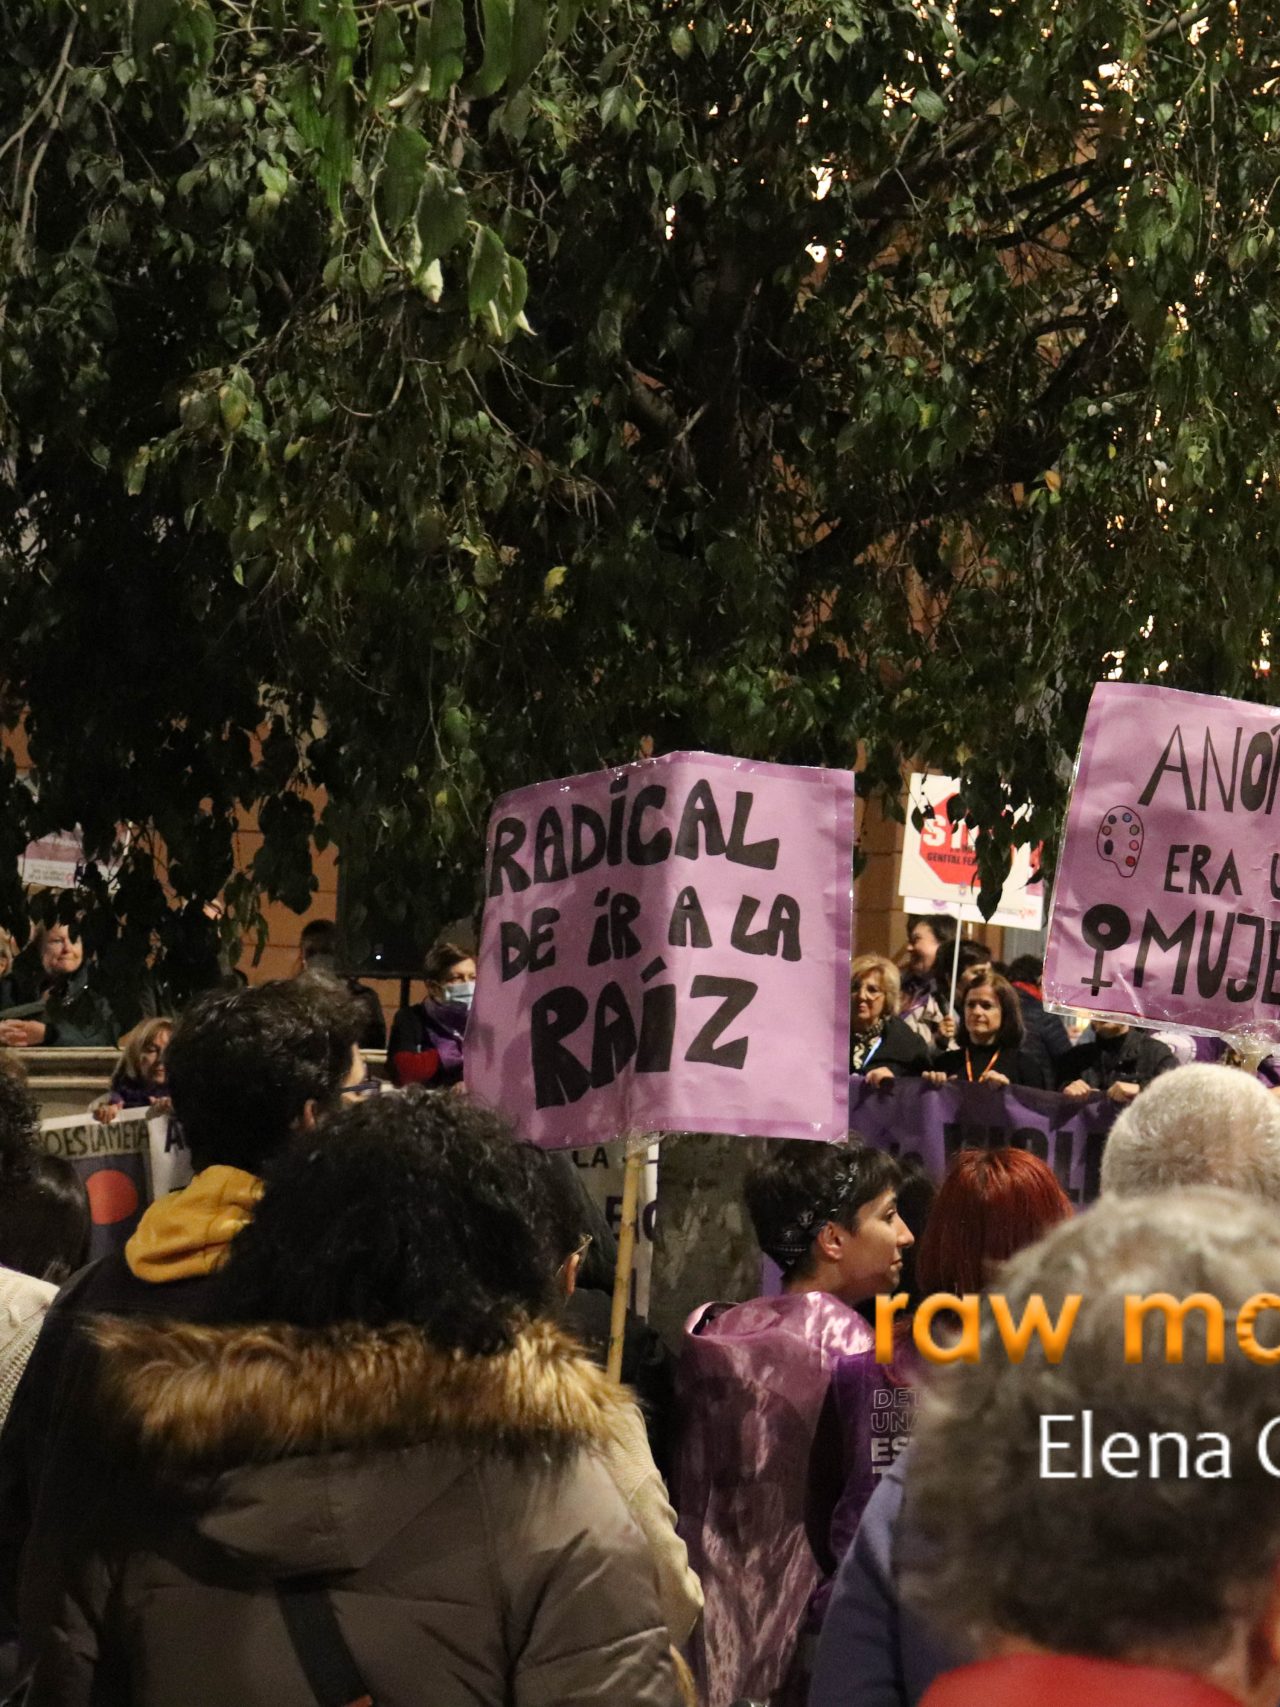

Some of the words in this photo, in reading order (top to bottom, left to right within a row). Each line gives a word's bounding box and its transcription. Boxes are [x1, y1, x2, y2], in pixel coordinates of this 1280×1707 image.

[1164, 844, 1243, 896] ERA
[501, 907, 560, 982] DE
[668, 886, 712, 948] A
[731, 894, 802, 961] LA
[531, 957, 758, 1110] RAÍZ
